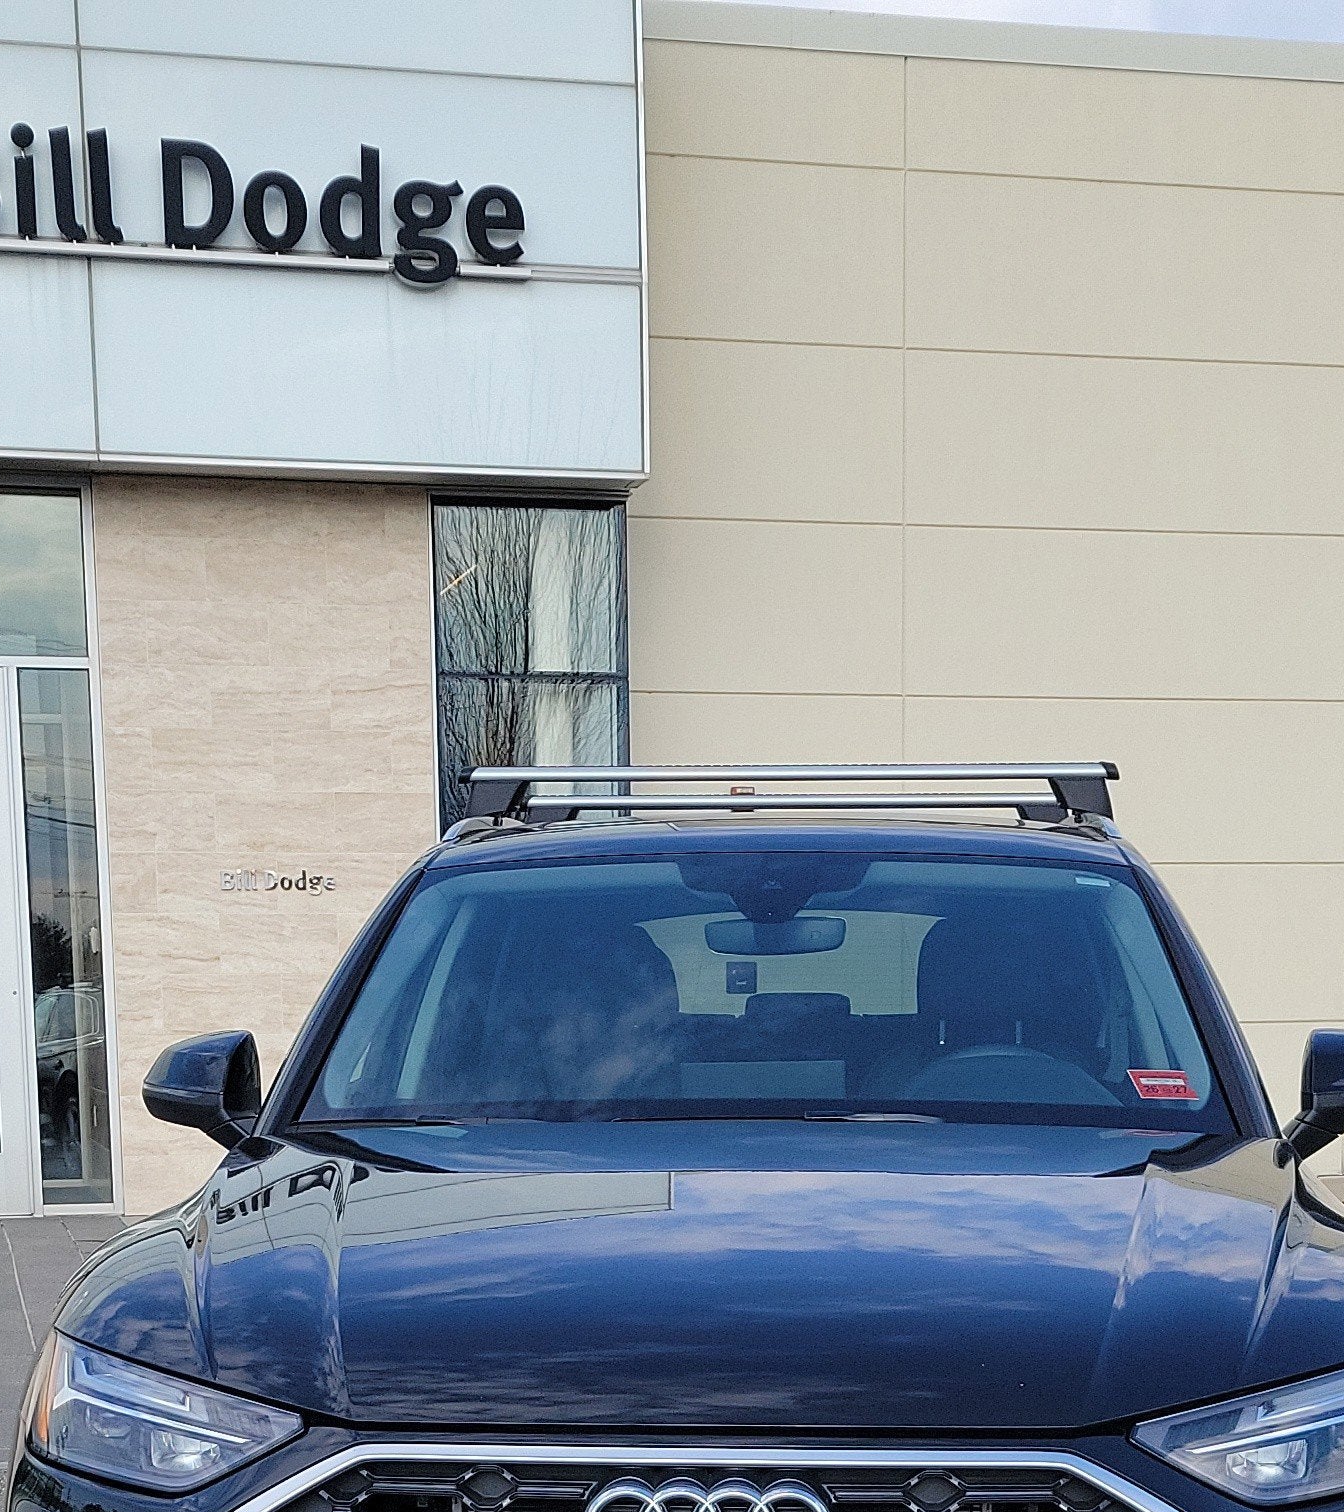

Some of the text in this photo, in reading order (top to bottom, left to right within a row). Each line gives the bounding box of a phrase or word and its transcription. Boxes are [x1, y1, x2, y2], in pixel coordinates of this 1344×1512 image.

[161, 138, 525, 284] Dodge
[220, 868, 337, 896] Bill Dodge
